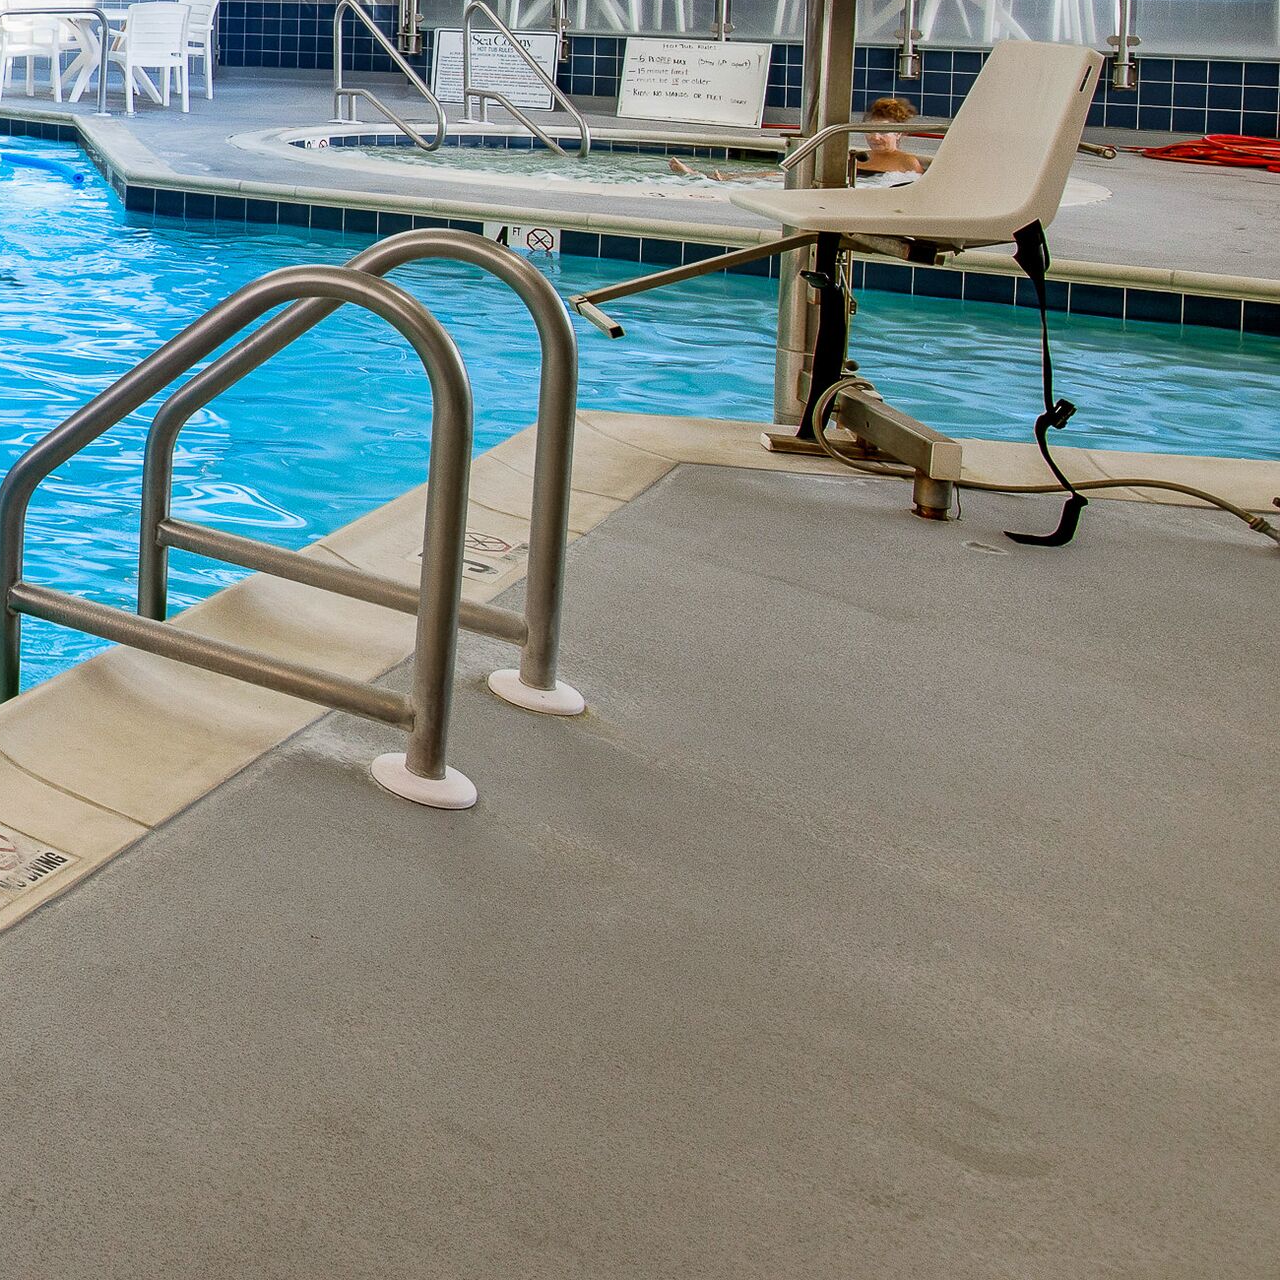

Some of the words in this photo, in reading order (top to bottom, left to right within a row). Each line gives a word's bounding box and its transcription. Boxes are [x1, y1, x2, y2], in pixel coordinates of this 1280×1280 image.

[472, 35, 492, 46] Sea
[496, 226, 509, 247] 4
[513, 227, 521, 236] FT
[27, 851, 69, 883] DIVING
